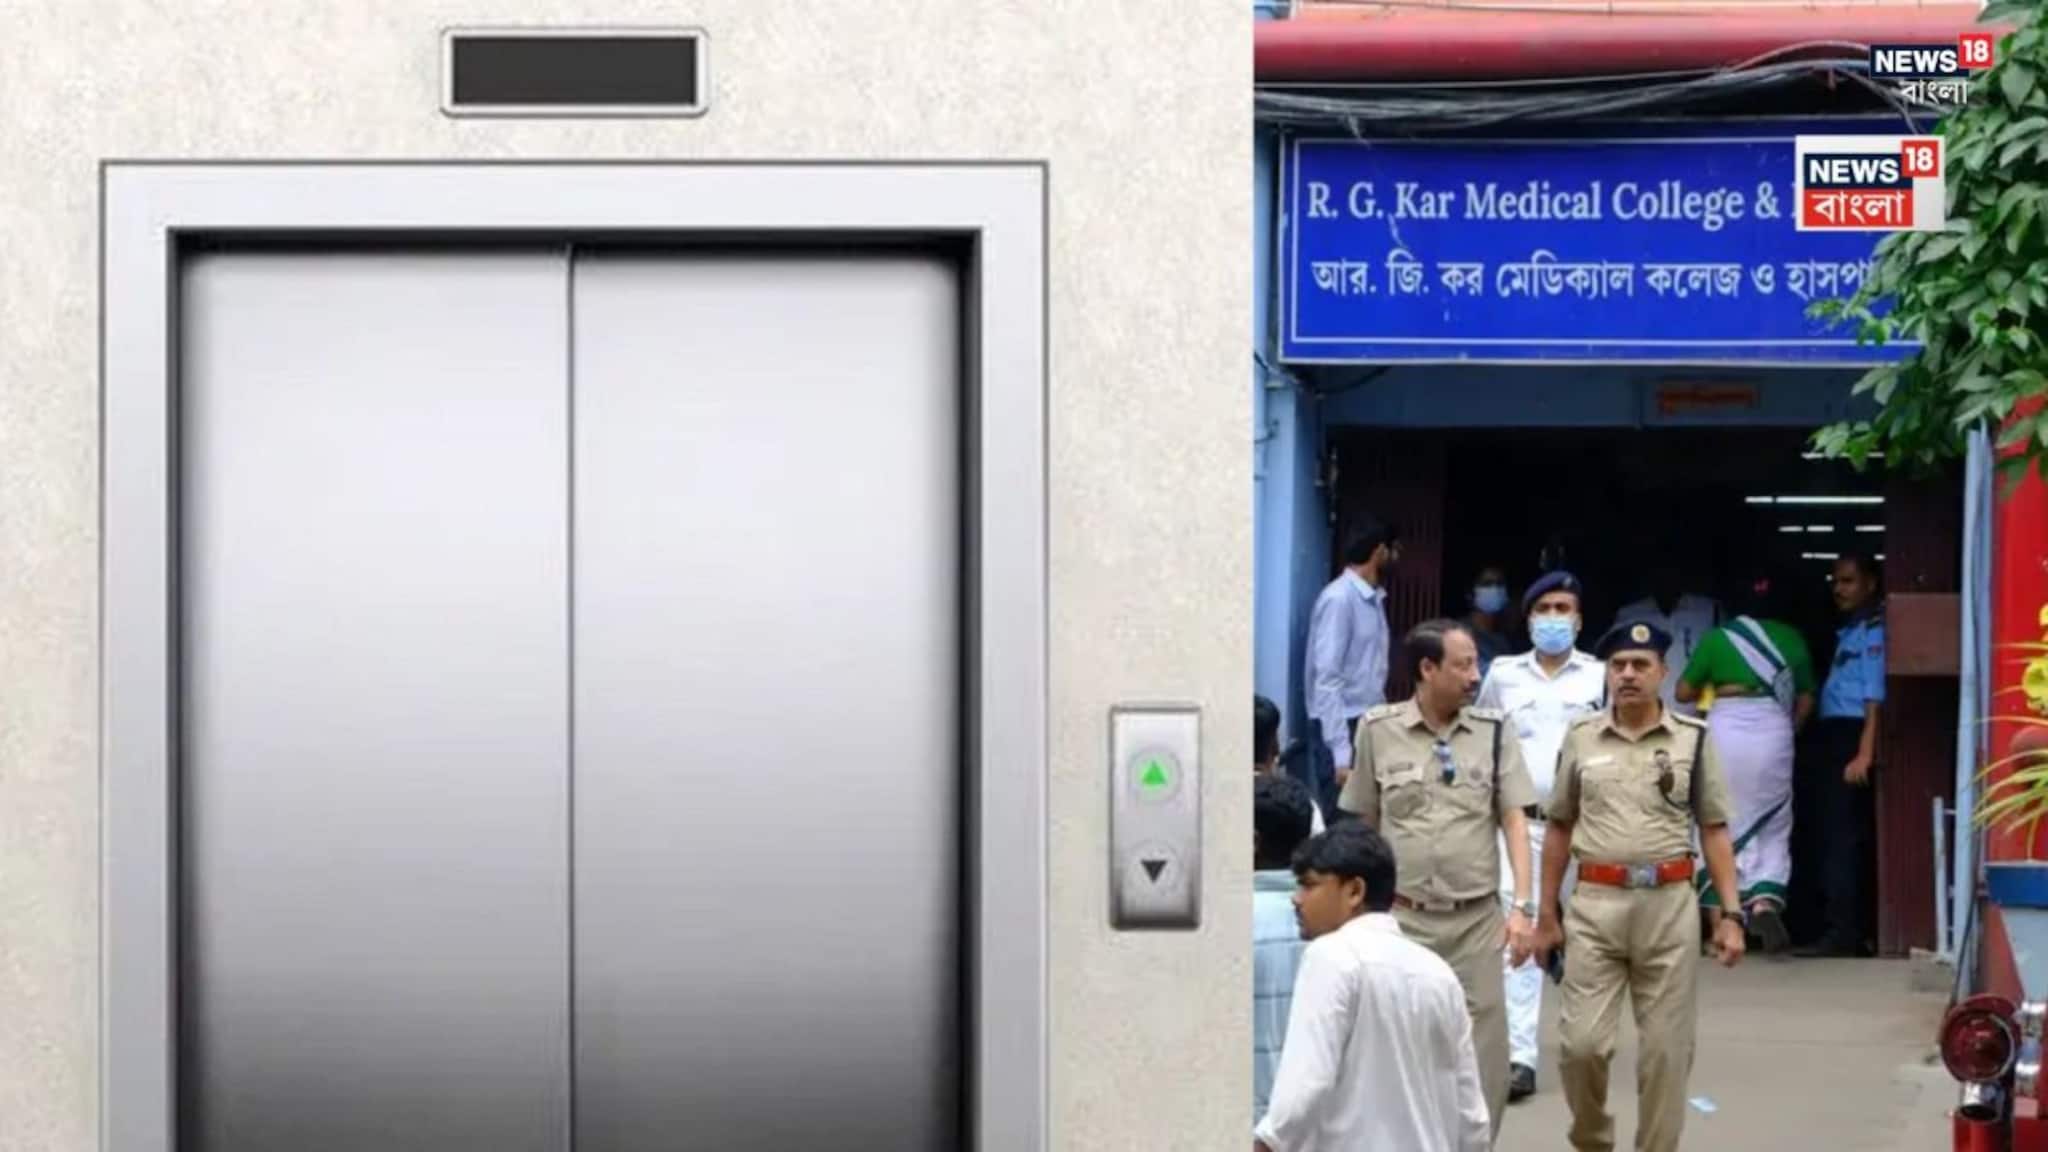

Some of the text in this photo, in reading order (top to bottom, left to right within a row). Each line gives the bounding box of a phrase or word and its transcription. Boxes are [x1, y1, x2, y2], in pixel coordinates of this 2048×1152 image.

[1307, 181, 1339, 219] R.
[1349, 181, 1384, 219] G.
[1395, 181, 1455, 219] Kar
[1464, 180, 1602, 220] Medical
[1612, 180, 1745, 232] College
[1754, 181, 1781, 219] &
[1311, 258, 1377, 296] আর.
[1384, 248, 1430, 296] জি.
[1437, 261, 1485, 296] কর
[1496, 249, 1635, 300] মেডিক্যাল
[1643, 261, 1742, 298] কলেজ
[1750, 263, 1775, 295] ও
